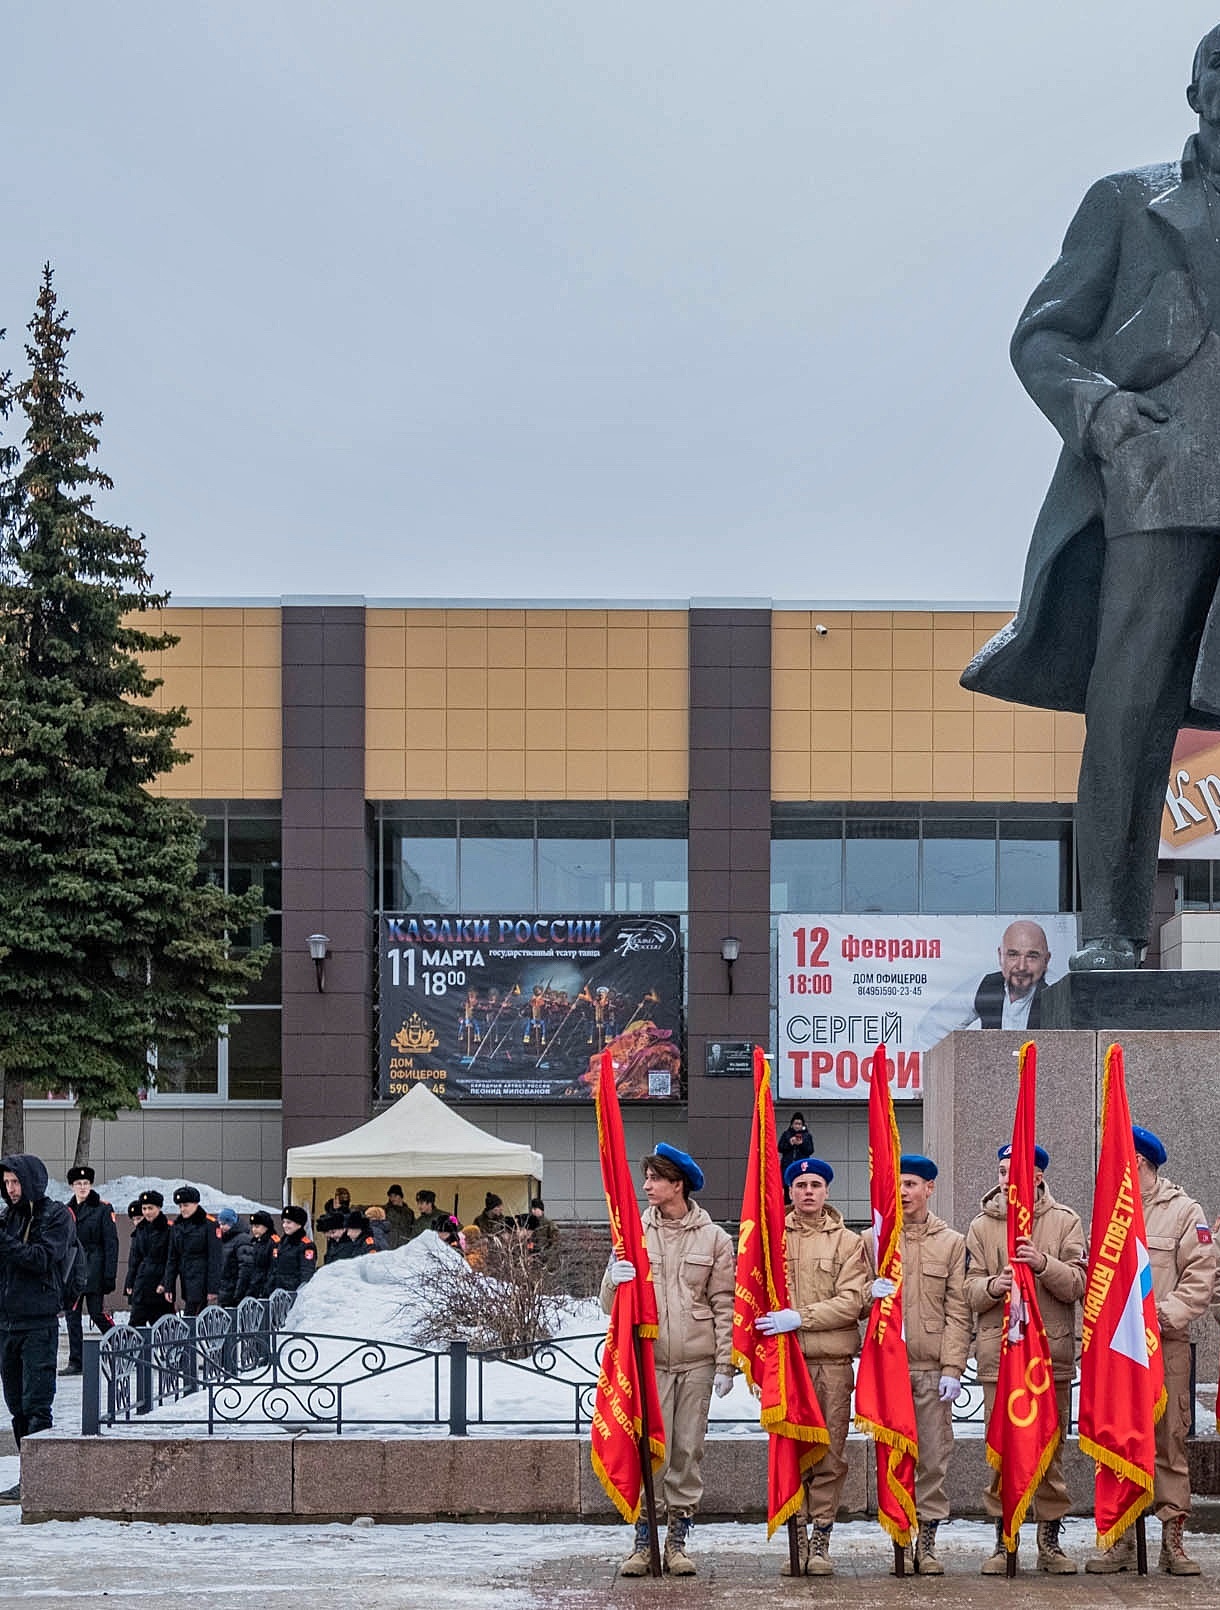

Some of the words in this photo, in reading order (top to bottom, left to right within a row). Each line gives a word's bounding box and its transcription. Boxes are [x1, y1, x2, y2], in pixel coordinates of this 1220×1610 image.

[388, 919, 490, 944] КАЗАКИ
[498, 919, 602, 944] РОССИИ
[793, 927, 829, 967] 12
[841, 934, 941, 962] февраля
[387, 948, 415, 986] 11
[422, 950, 485, 967] МАРТА
[788, 974, 832, 994] 18:00
[852, 973, 874, 985] ДОМ
[876, 973, 927, 985] ОФИЦЕРОВ
[857, 986, 922, 996] 8(495)590-23-45
[786, 1011, 902, 1044] СЕРГЕЙ
[389, 1058, 413, 1069] ДОМ
[389, 1070, 447, 1080] ОФИЦЕРОВ
[1083, 1262, 1115, 1324] НАШУ
